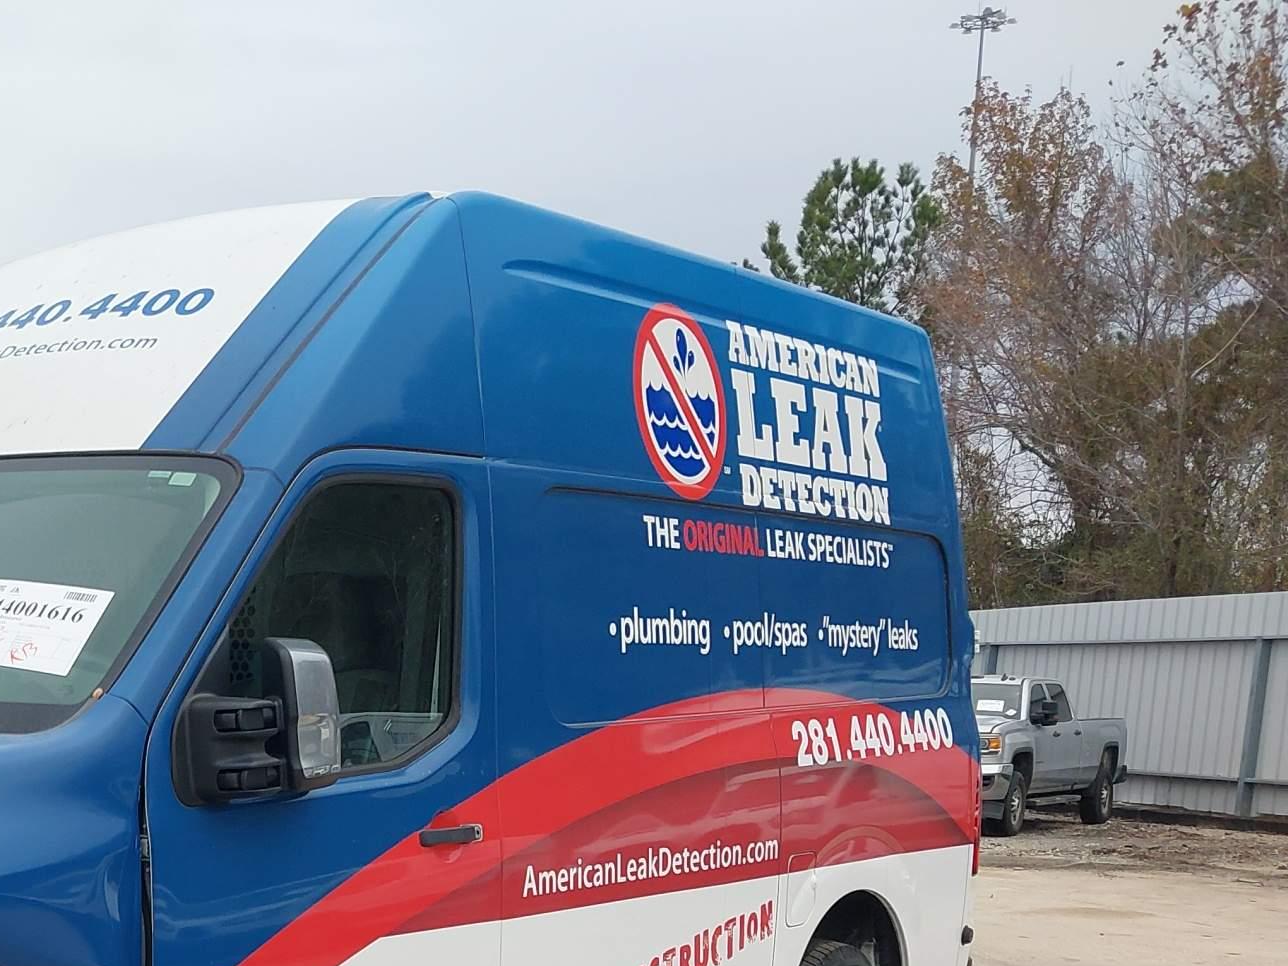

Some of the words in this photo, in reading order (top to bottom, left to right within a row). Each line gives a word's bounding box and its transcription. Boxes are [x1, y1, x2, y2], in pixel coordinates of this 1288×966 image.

[725, 320, 881, 398] AMERICAN
[731, 368, 888, 482] LEAK
[739, 463, 891, 526] DETECTION
[643, 515, 681, 549] THE
[683, 520, 764, 557] ORIGINAL
[766, 528, 806, 561] LEAK
[887, 618, 919, 650] leaks
[791, 707, 954, 768] 281.440.4400
[522, 838, 780, 898] AmericanLeakDetection.com
